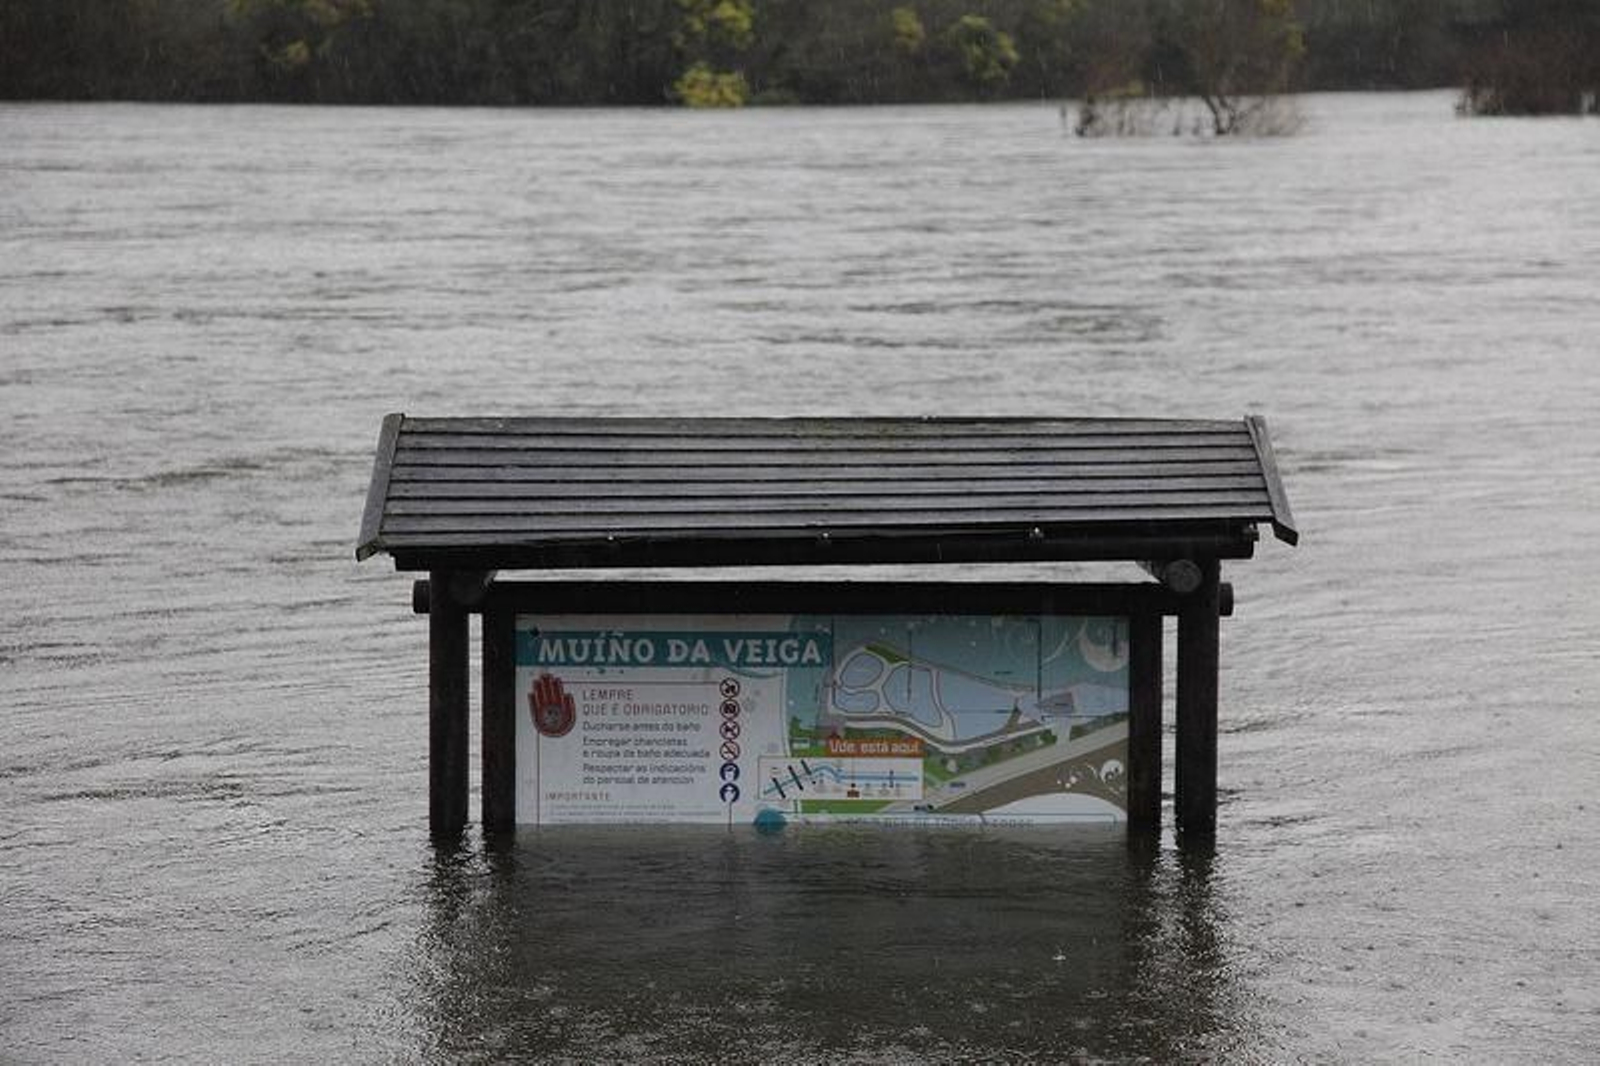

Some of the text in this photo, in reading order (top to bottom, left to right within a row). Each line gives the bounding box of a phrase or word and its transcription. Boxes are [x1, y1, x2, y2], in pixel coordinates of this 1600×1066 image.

[667, 639, 711, 662] DA
[723, 639, 822, 663] VEIGA
[582, 704, 606, 716] QUE
[623, 704, 710, 716] OBRIGATORIO
[582, 721, 702, 733] Ducharse antes do baño
[582, 736, 688, 748] Empregar chancletas
[591, 750, 620, 760] roupa
[623, 750, 636, 759] de
[637, 749, 662, 759] baño
[664, 749, 711, 759] adecuada
[636, 765, 648, 773] as
[582, 776, 596, 785] do
[637, 776, 650, 785] de
